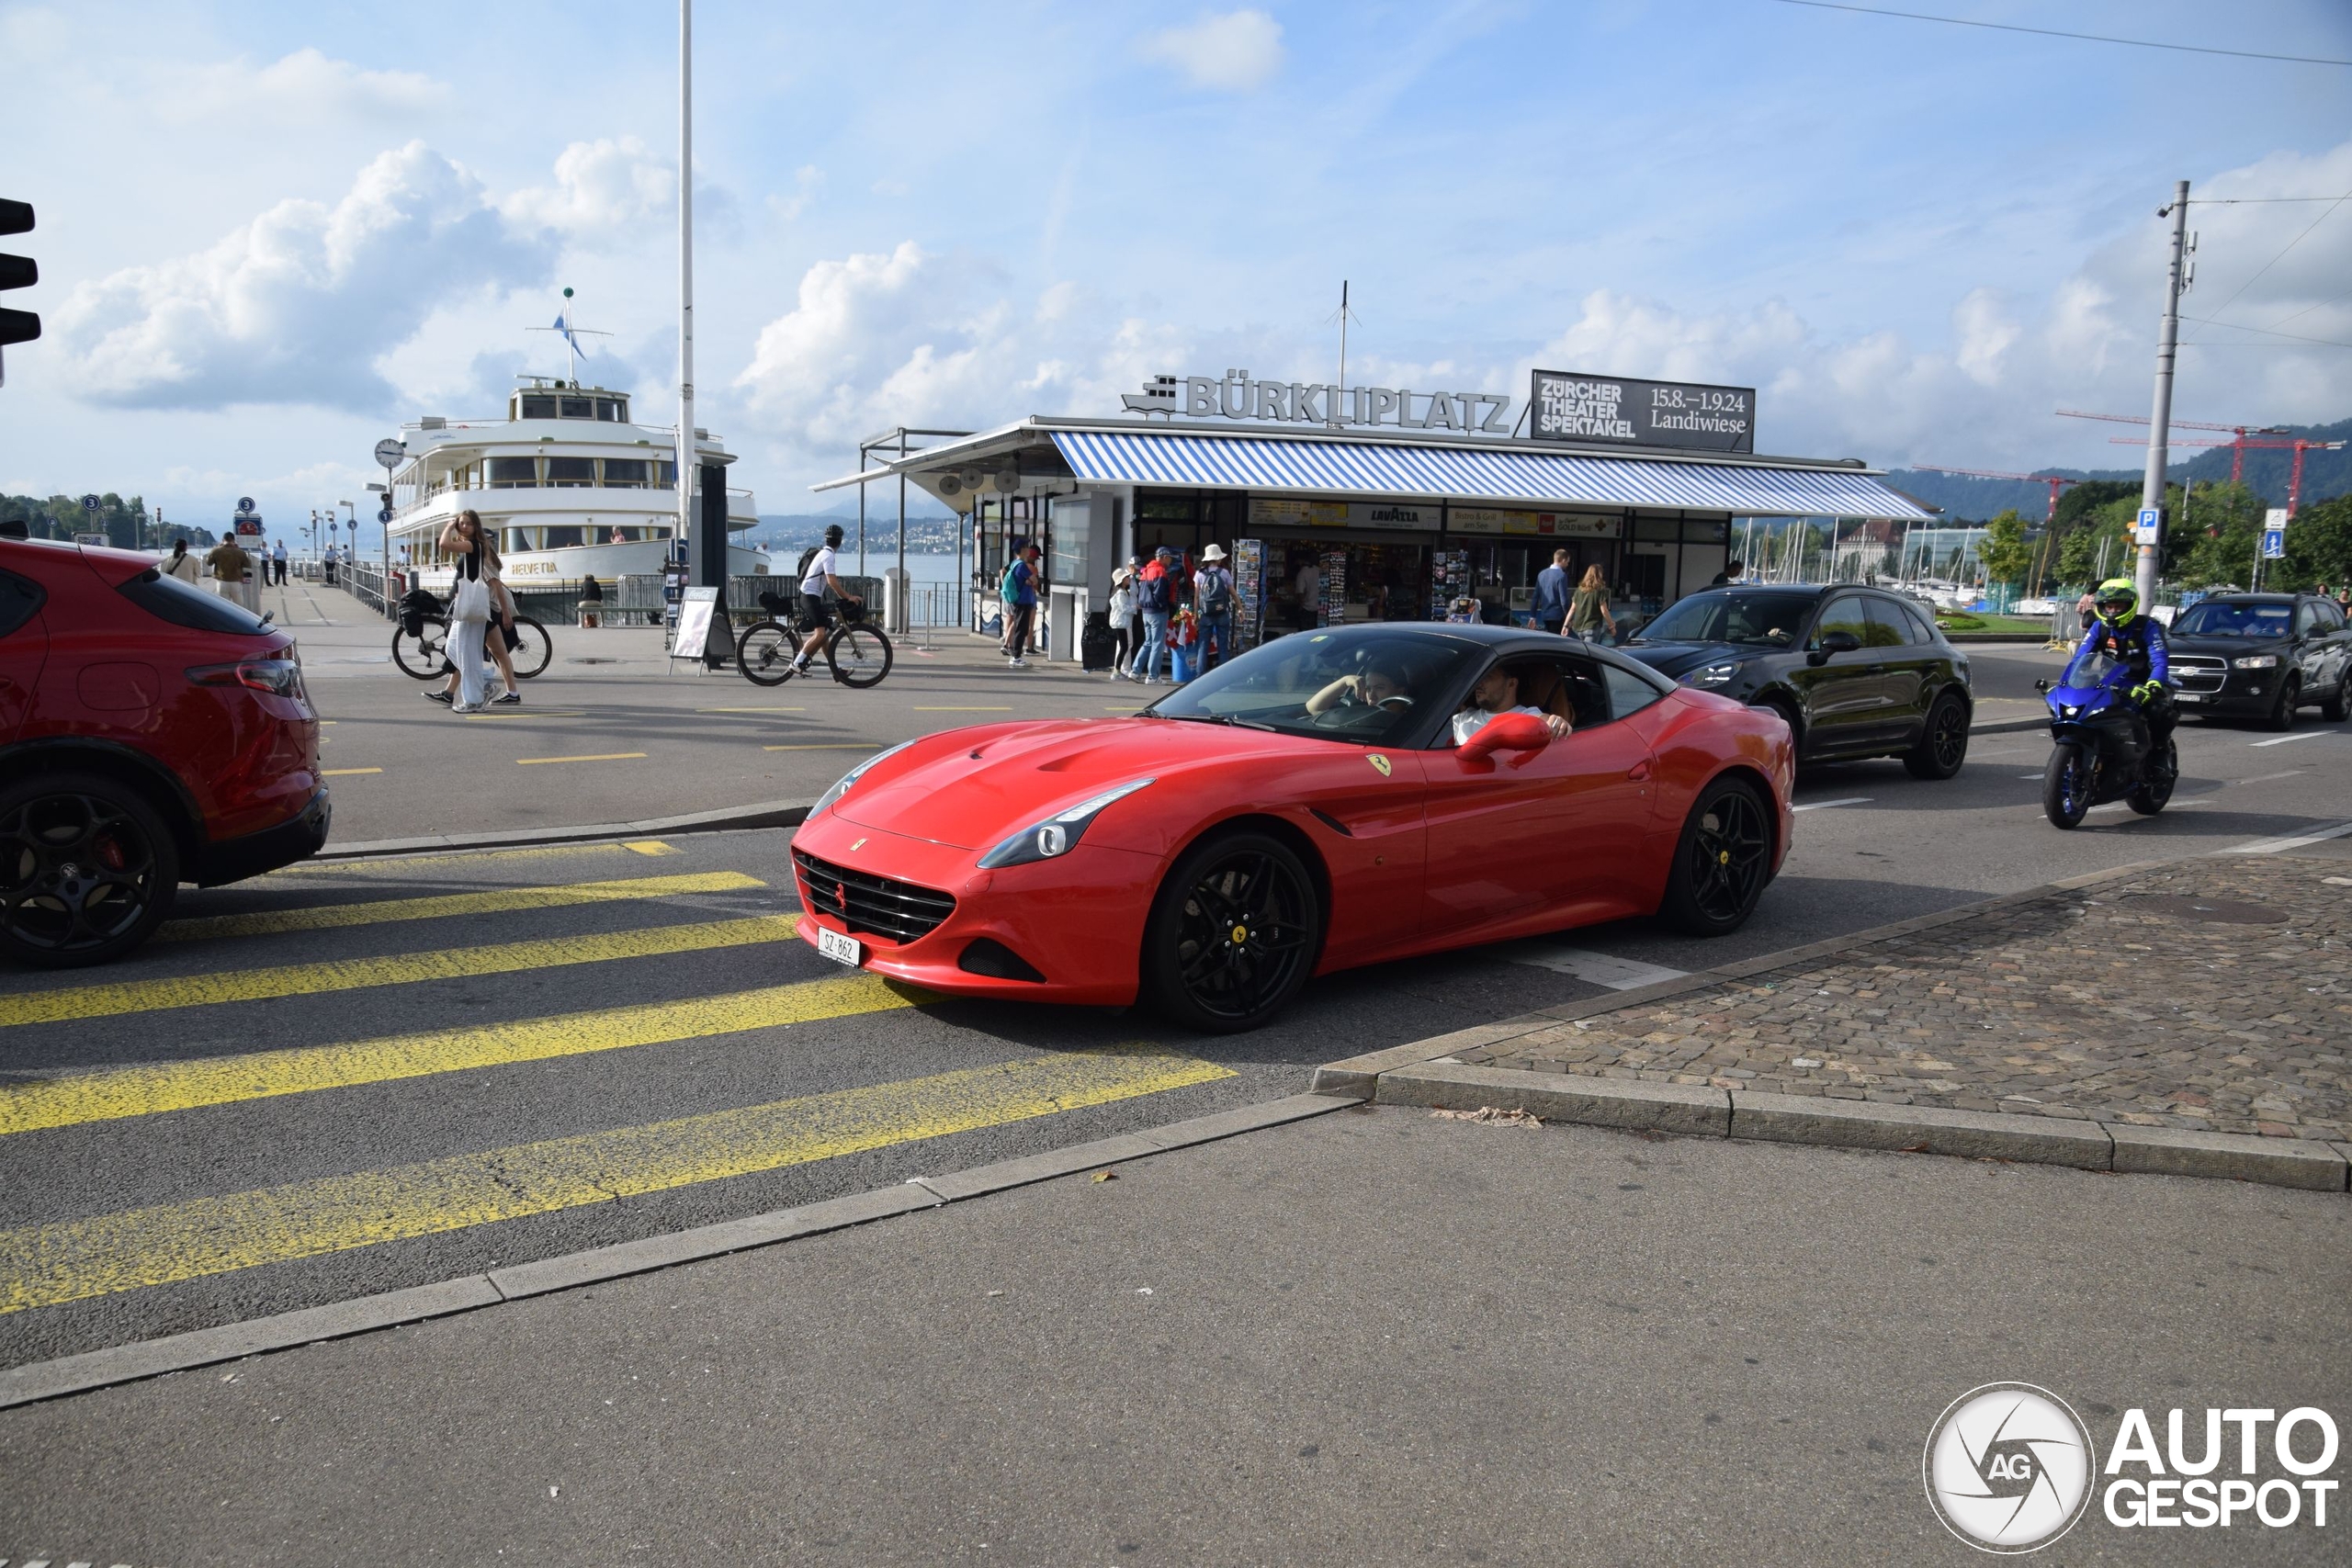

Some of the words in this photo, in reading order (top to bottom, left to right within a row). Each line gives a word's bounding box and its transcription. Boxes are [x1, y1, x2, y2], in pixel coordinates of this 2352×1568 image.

[1187, 369, 1510, 433] BÜRKLIPLATZ
[1541, 378, 1622, 402] ZÜRCHER
[1541, 397, 1618, 420] THEATER
[1540, 414, 1636, 438] SPEKTAKEL
[1651, 410, 1747, 434] Landiwiese
[1371, 507, 1419, 523] LAVAZZA
[1454, 512, 1475, 520] Bistro
[1476, 513, 1481, 521] &
[1482, 513, 1497, 521] Grill
[2143, 513, 2154, 526] P
[512, 561, 559, 575] HELVETIA
